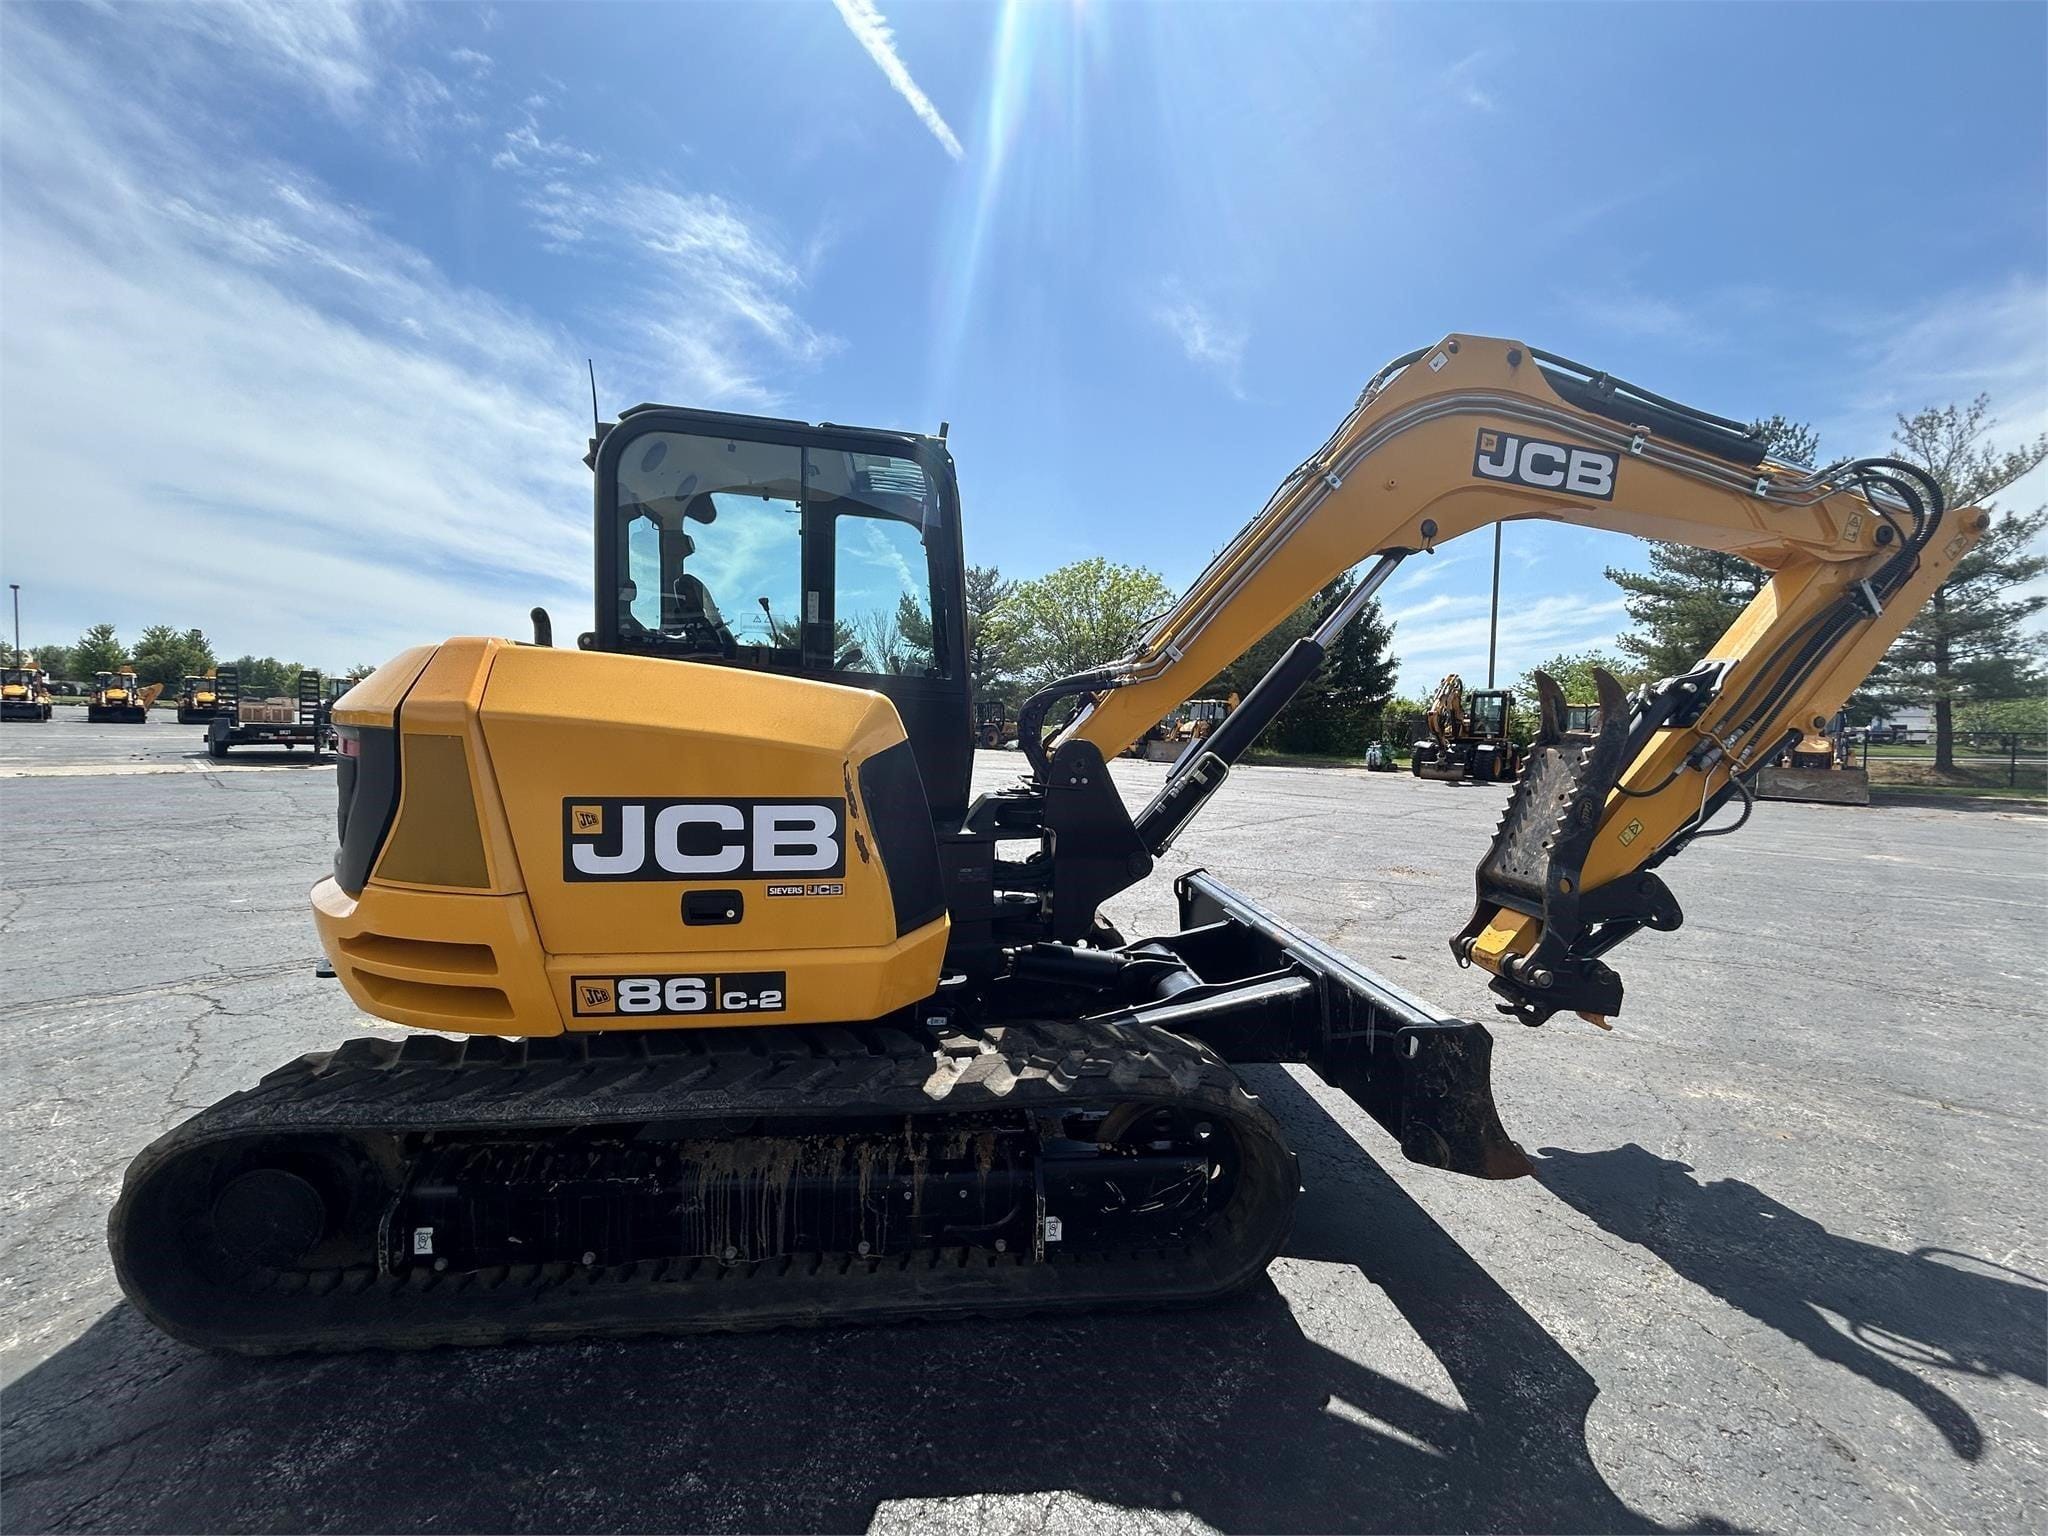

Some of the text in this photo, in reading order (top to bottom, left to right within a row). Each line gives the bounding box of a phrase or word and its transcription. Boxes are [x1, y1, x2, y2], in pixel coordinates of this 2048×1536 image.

[1478, 437, 1613, 495] JCB
[579, 813, 599, 826] JCB
[572, 804, 839, 874] JCB
[769, 885, 842, 895] SIEVERS JCB
[586, 988, 609, 1003] JCB
[618, 978, 706, 1012] 86
